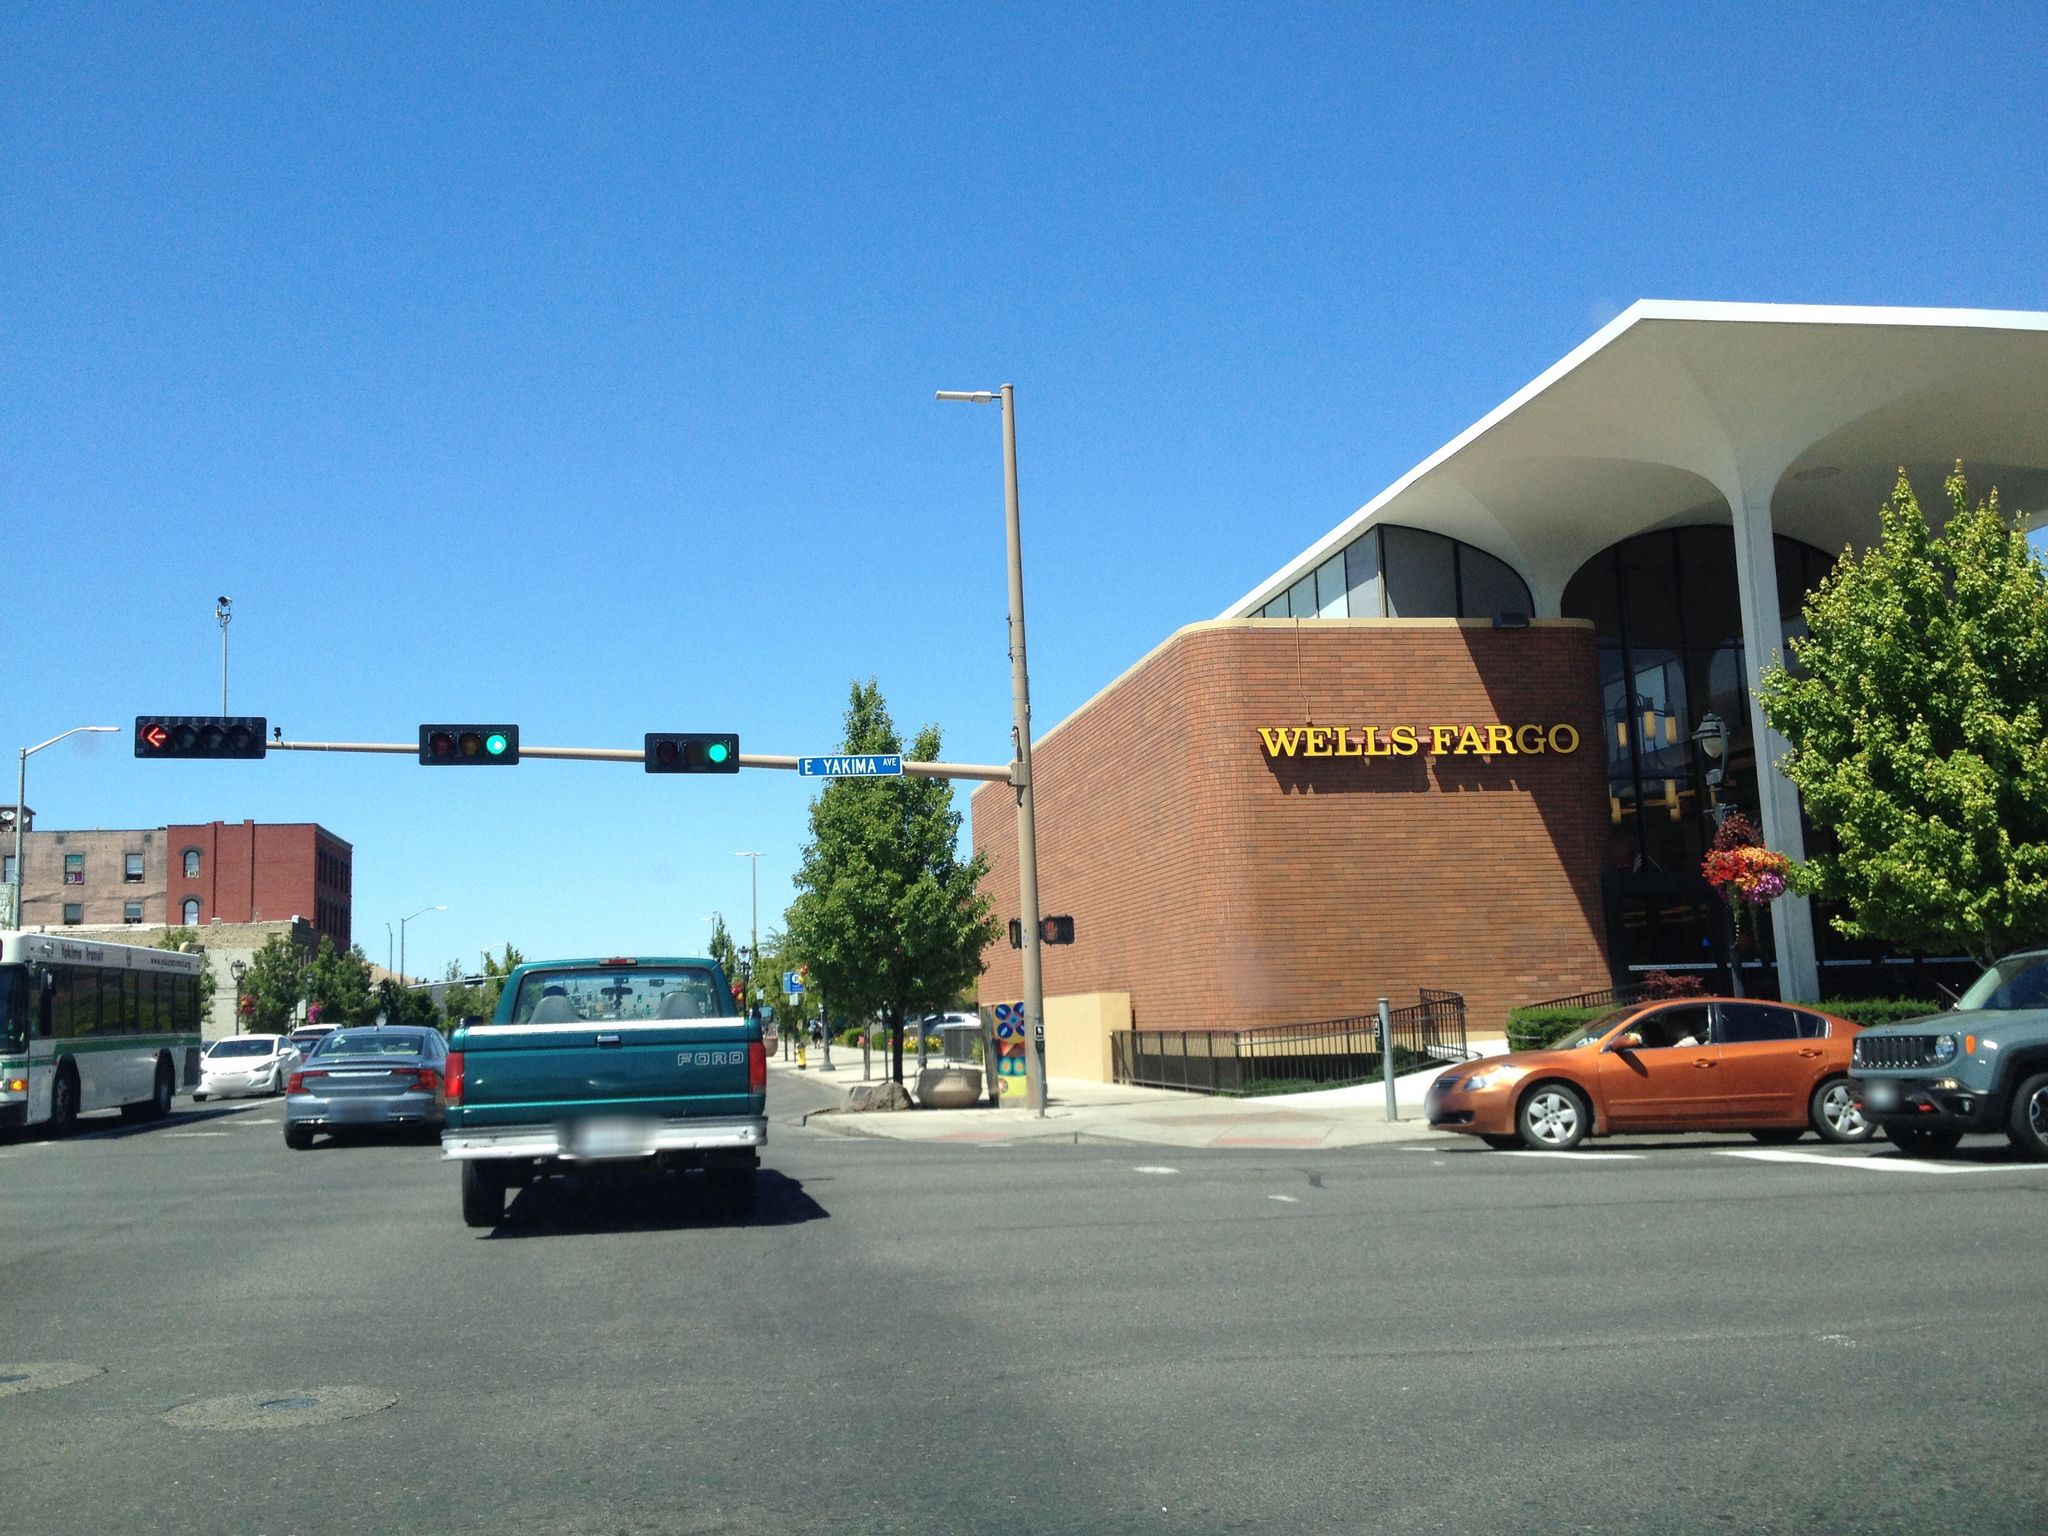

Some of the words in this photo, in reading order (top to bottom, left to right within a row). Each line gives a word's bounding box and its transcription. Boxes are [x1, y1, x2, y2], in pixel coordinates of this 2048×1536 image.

[1257, 725, 1420, 758] WELLS
[1428, 723, 1580, 756] FARGO
[804, 759, 814, 775] E
[823, 758, 877, 774] YAKIMA
[882, 757, 897, 766] AVE
[677, 1051, 744, 1066] FORD
